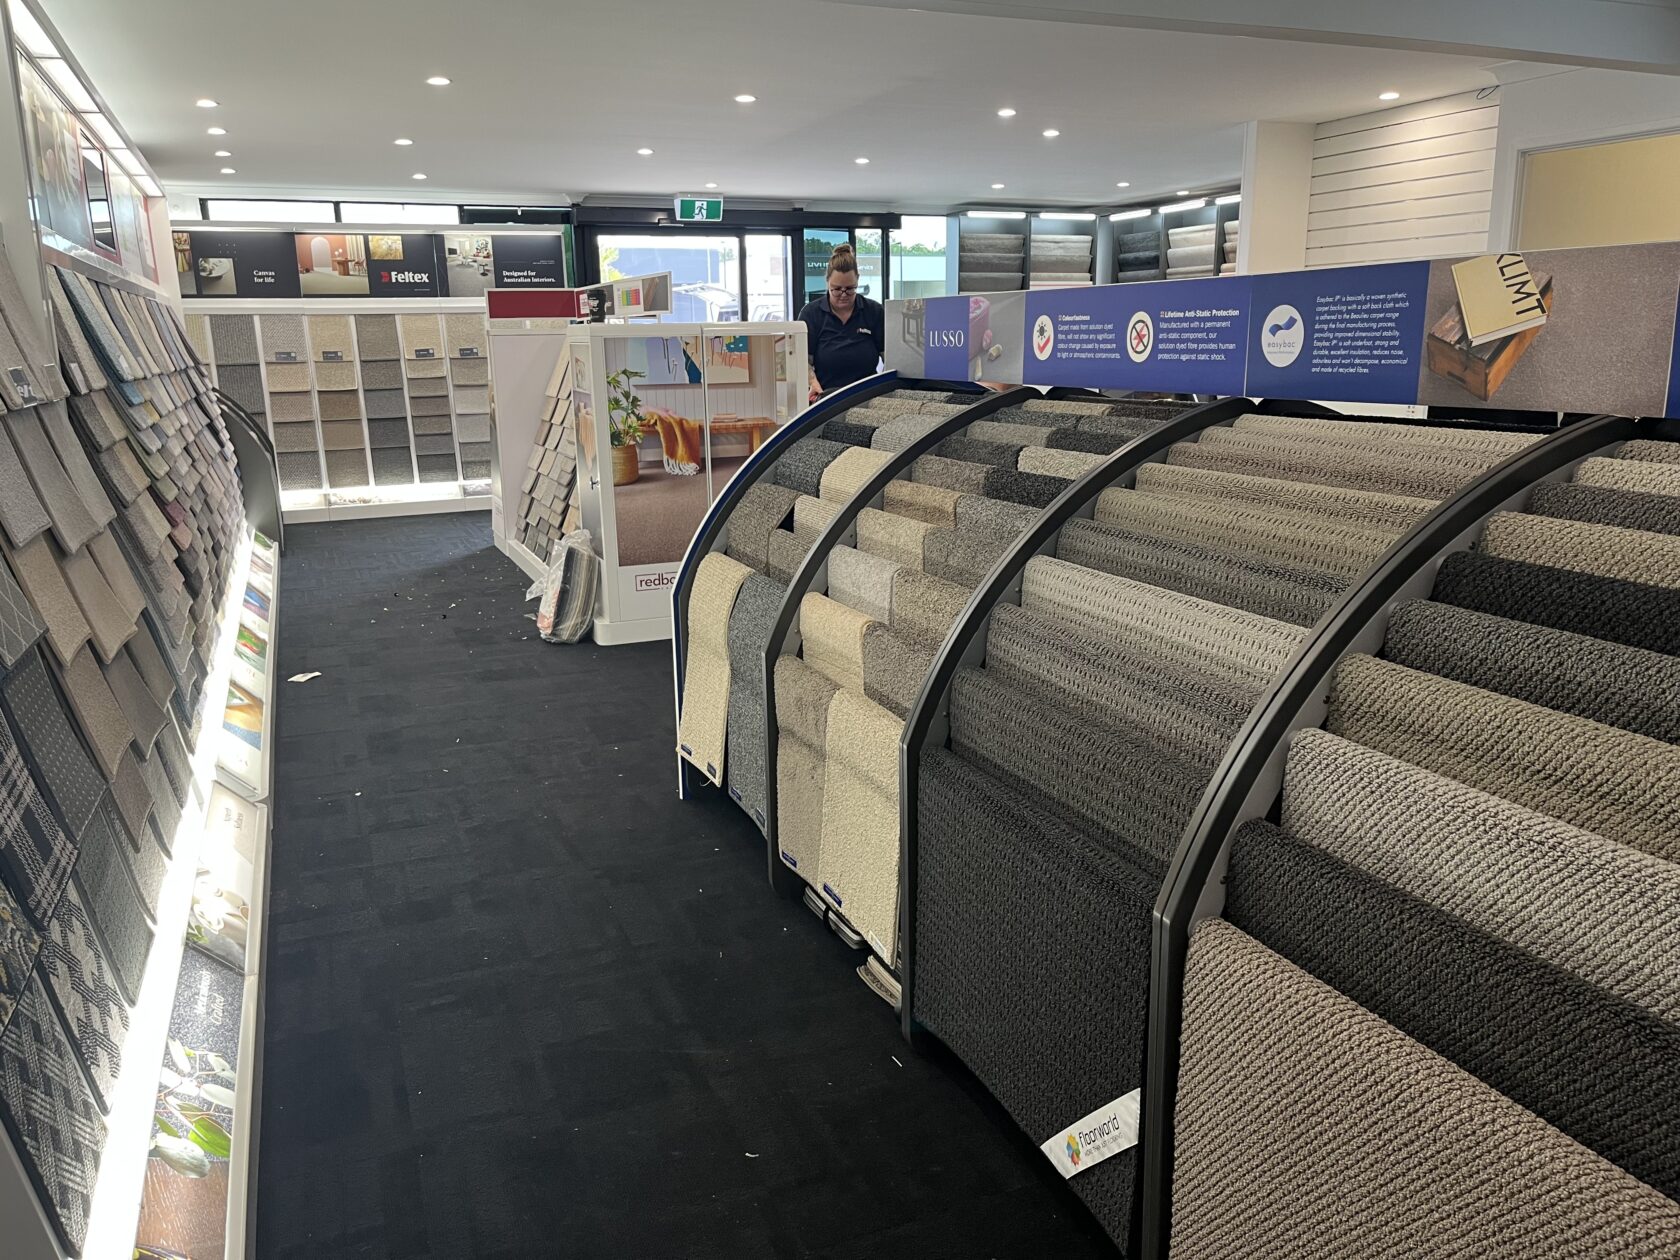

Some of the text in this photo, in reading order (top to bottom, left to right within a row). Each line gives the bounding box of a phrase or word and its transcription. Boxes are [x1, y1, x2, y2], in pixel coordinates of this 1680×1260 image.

[391, 271, 429, 283] Feltex
[1346, 293, 1366, 301] basically
[1386, 292, 1408, 301] synthetic
[1330, 304, 1347, 312] backing
[1362, 302, 1371, 310] soft
[1383, 301, 1394, 309] cloth
[1395, 300, 1410, 308] which
[1185, 309, 1211, 318] Anti-Static
[1212, 309, 1240, 317] Protection
[1320, 312, 1337, 320] adhered
[1370, 312, 1385, 320] carpet
[1385, 311, 1400, 320] range
[1205, 321, 1230, 329] permanent
[1314, 322, 1328, 330] during
[1346, 320, 1378, 330] manufacturing
[930, 330, 964, 347] LUSSO
[1097, 333, 1116, 341] significant
[1181, 332, 1208, 340] component,
[1313, 331, 1334, 339] providing
[1334, 330, 1355, 339] improved
[1176, 343, 1187, 351] dyed
[1187, 342, 1198, 350] fibre
[1198, 342, 1218, 350] provides
[1219, 342, 1236, 350] human
[1267, 341, 1296, 350] easybac
[1374, 340, 1389, 348] strong
[1372, 347, 1390, 355] reduces
[1157, 353, 1180, 361] protection
[1180, 353, 1197, 361] against
[1210, 353, 1226, 361] shock.
[1339, 366, 1356, 374] recycled
[639, 573, 676, 588] redbo
[1079, 1112, 1119, 1148] floorworld
